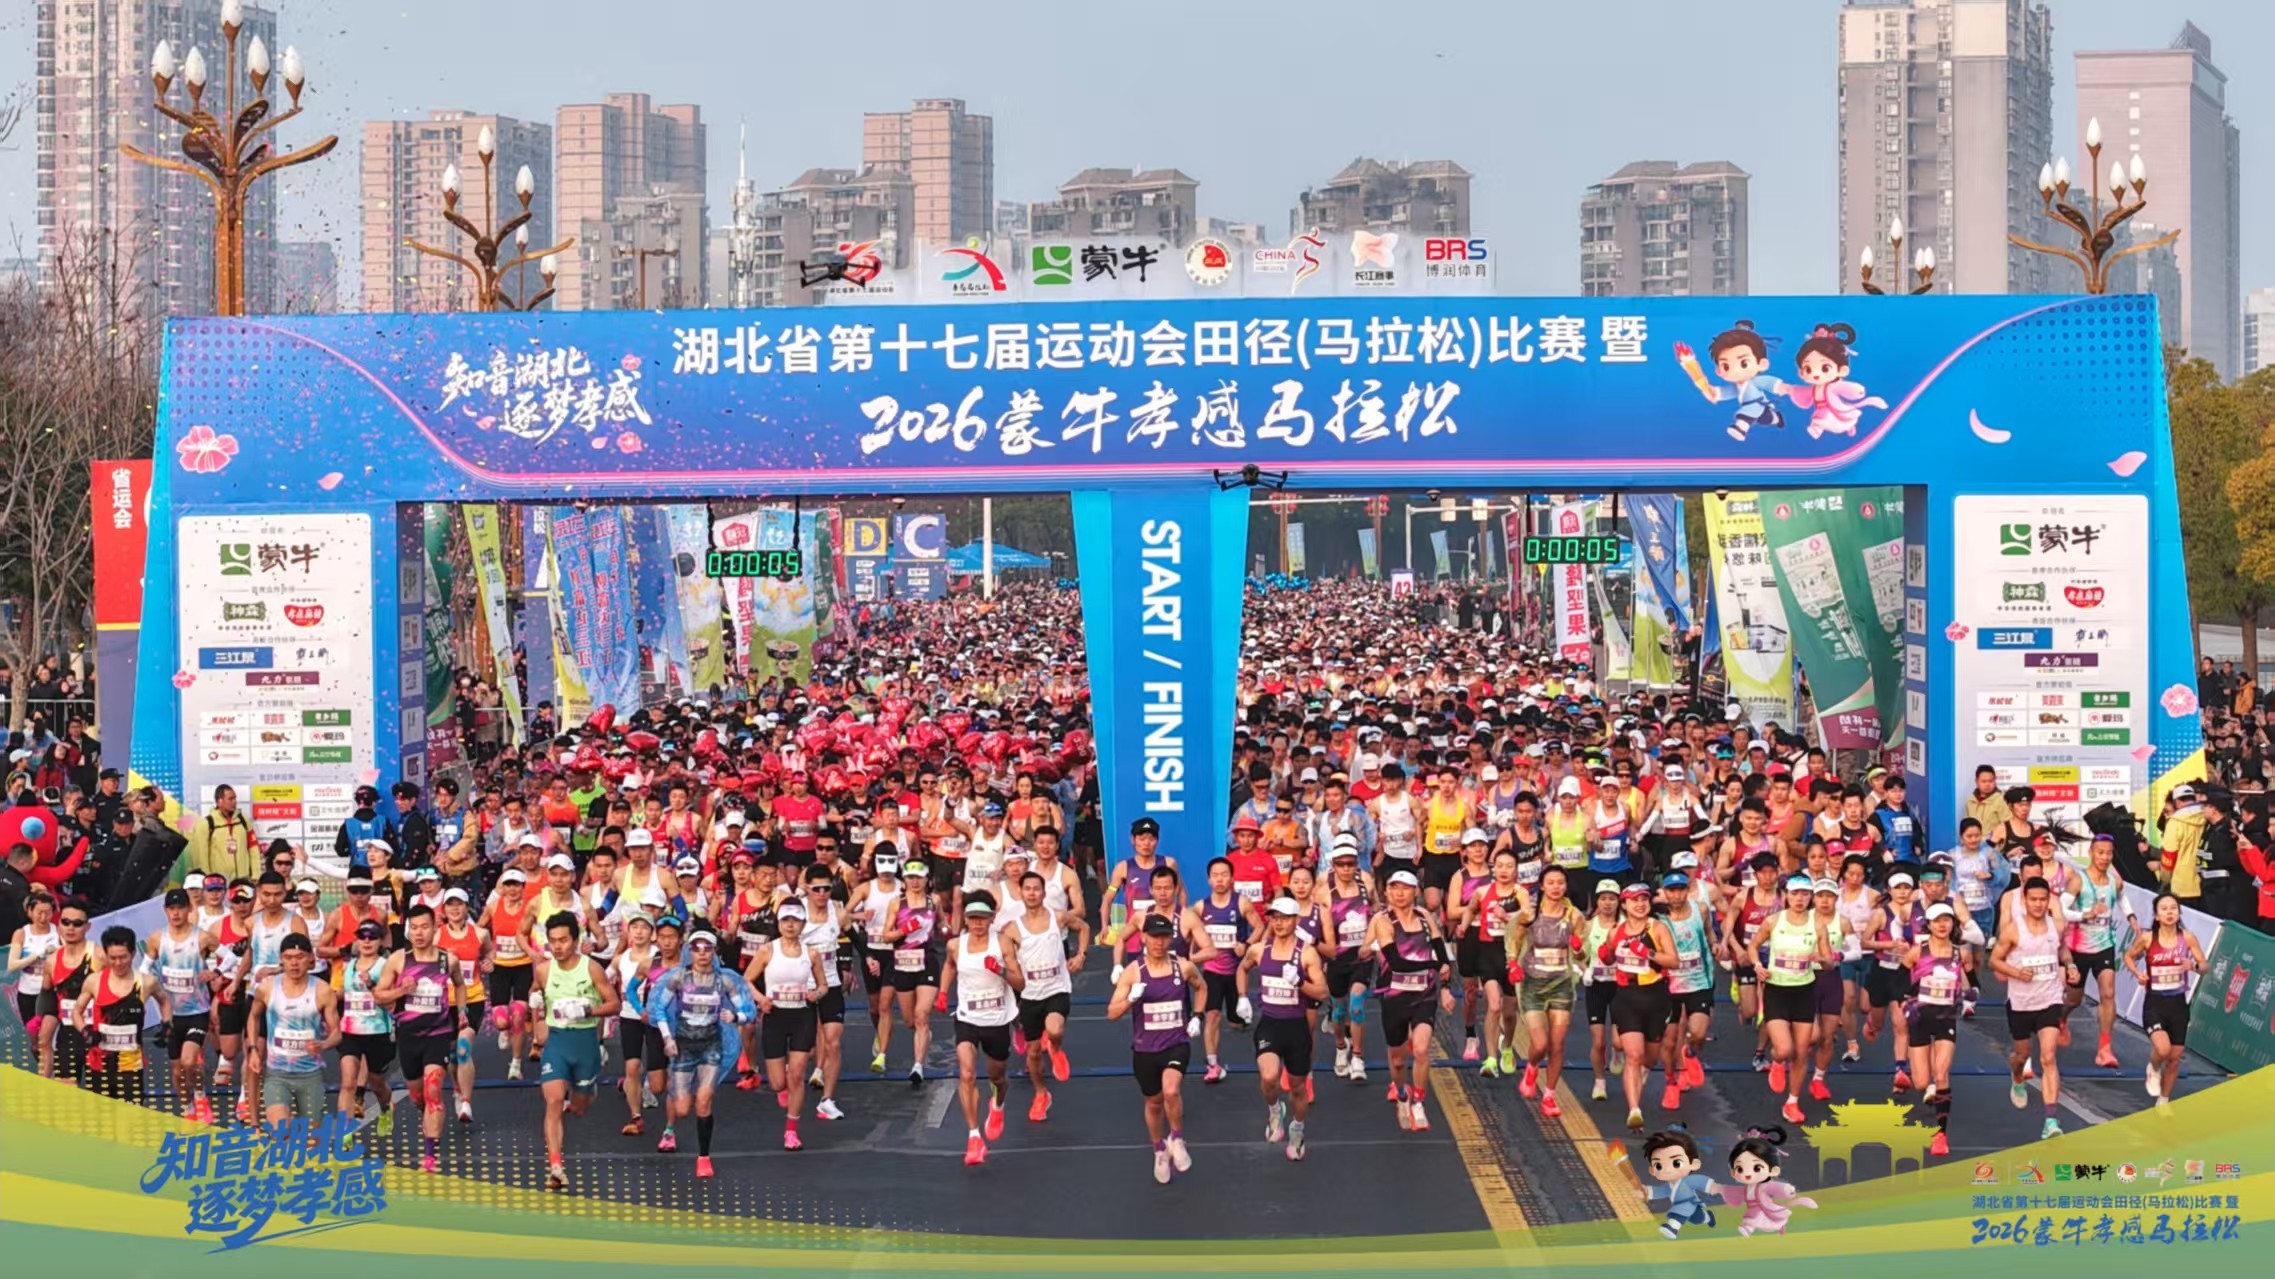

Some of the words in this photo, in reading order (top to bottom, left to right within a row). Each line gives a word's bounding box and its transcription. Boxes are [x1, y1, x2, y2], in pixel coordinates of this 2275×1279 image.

[1081, 245, 1157, 282] 蒙牛
[1255, 250, 1296, 261] CHINA
[1426, 239, 1487, 260] BRS
[1426, 264, 1487, 278] 博润体育
[671, 315, 1587, 376] 湖北省第十七届运动会田径(马拉松)比赛
[1599, 315, 1649, 364] 暨
[434, 346, 591, 414] 知音湖北
[498, 368, 653, 446] 逐梦孝感
[860, 378, 1461, 455] 2026蒙牛孝感马拉松
[111, 467, 133, 530] 省运会
[853, 520, 882, 551] D
[903, 516, 940, 559] C
[1526, 538, 1617, 561] 0:00:05
[2038, 524, 2100, 555] 蒙牛
[257, 543, 320, 574] 蒙牛
[708, 551, 799, 576] 0:00:05
[1141, 519, 1182, 641] START
[1143, 682, 1184, 812] FINISH
